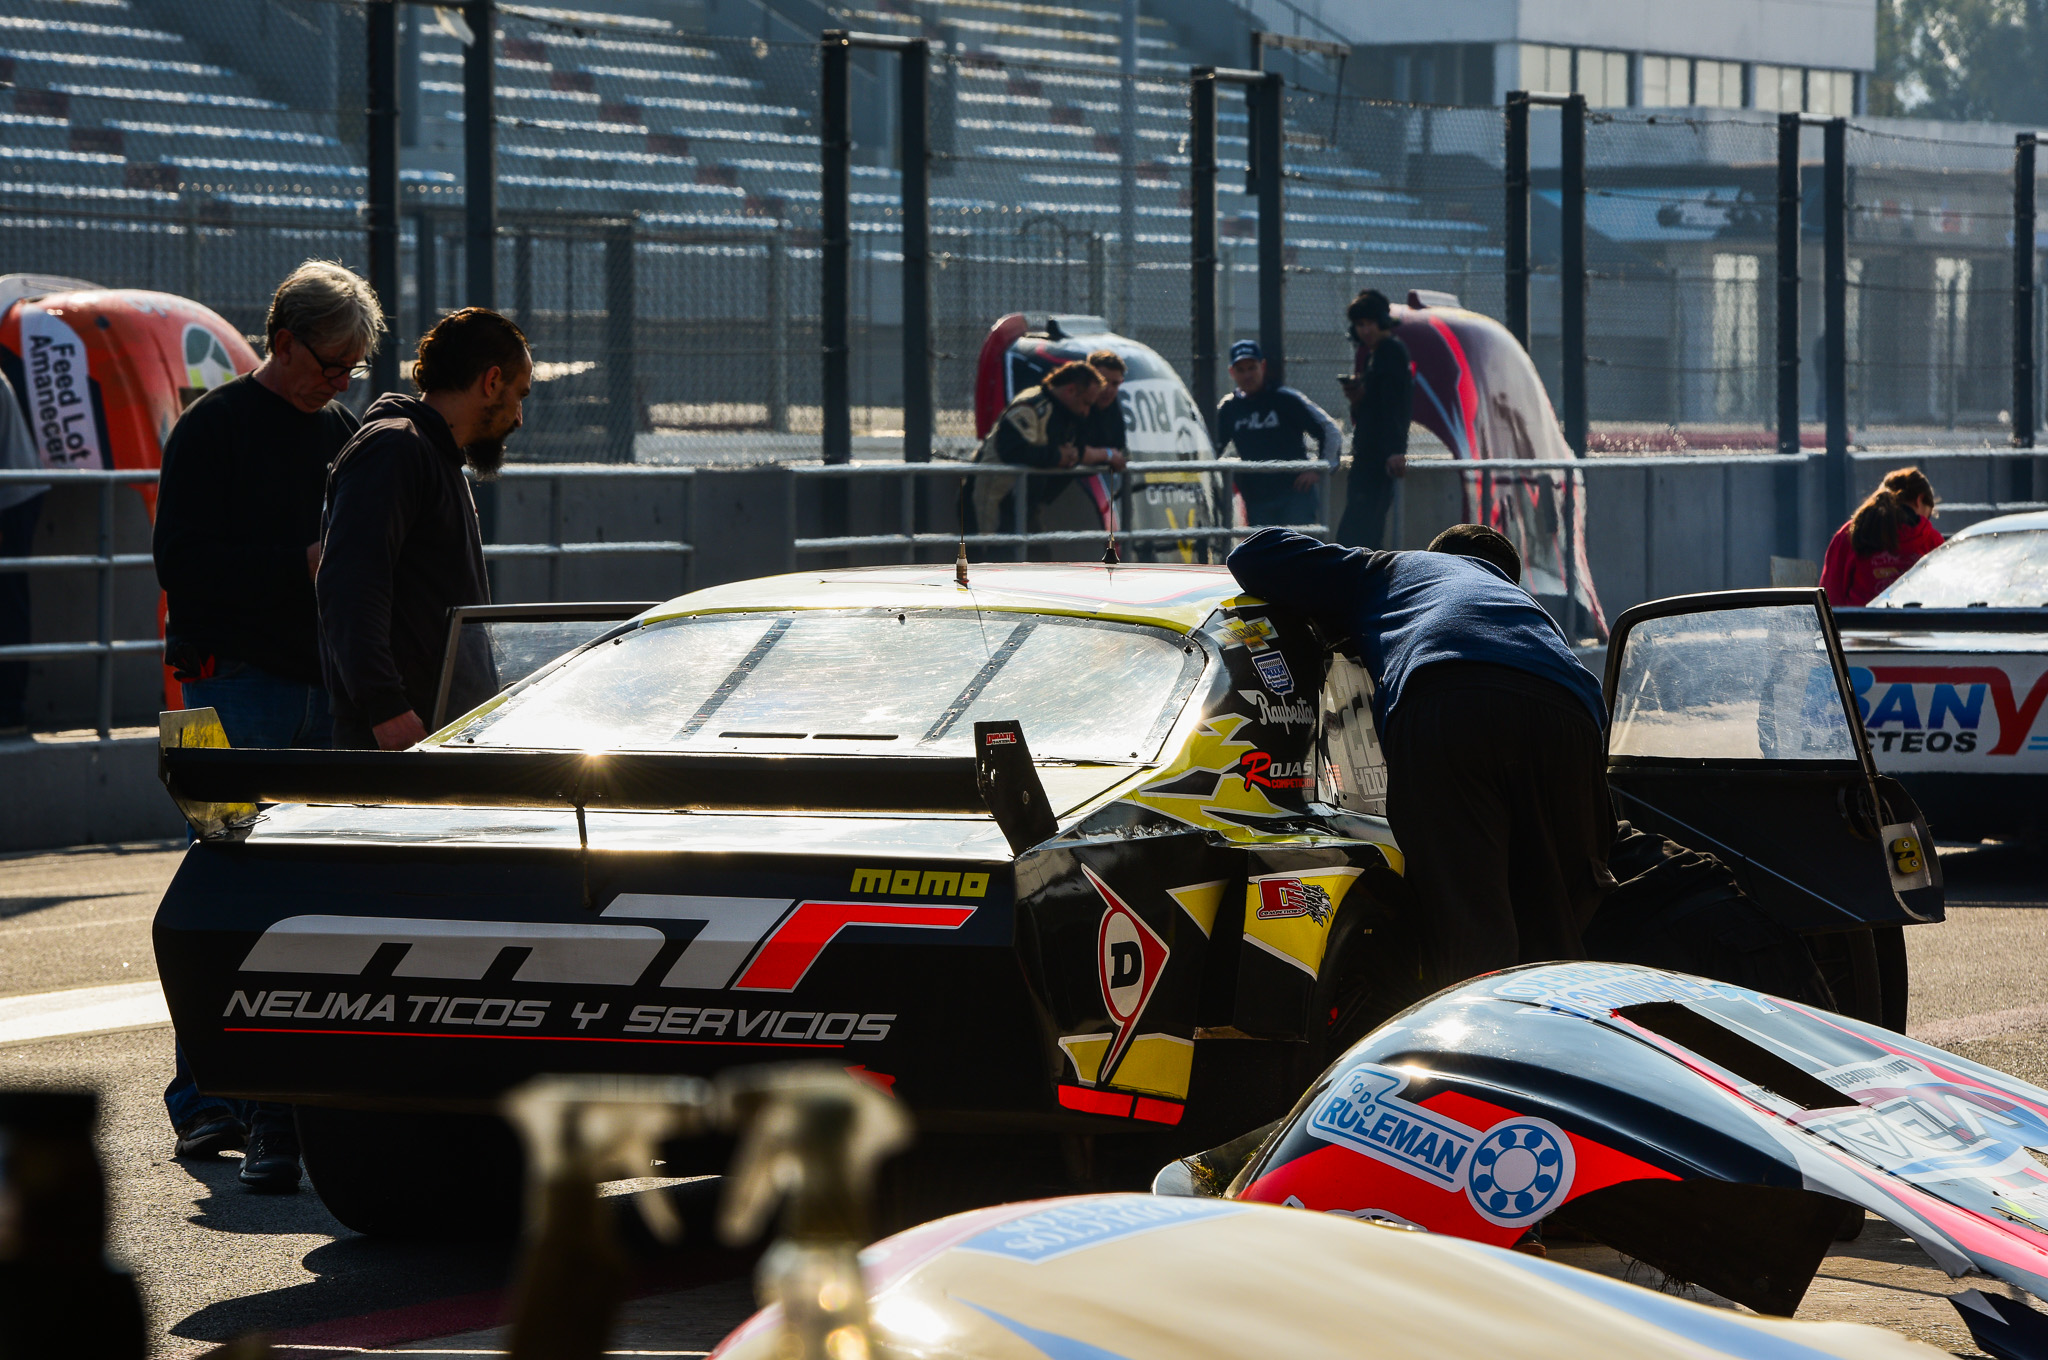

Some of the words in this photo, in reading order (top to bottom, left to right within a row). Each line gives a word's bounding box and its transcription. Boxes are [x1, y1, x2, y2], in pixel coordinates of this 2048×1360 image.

[29, 335, 68, 464] Amanecer
[51, 343, 83, 407] Feed
[62, 413, 92, 460] Lot
[1110, 941, 1142, 989] D
[223, 990, 552, 1027] NEUMATICOS
[571, 1002, 609, 1030] Y
[623, 1005, 897, 1041] SERVICIOS
[1348, 1075, 1376, 1117] TODO
[1319, 1097, 1468, 1175] RULEMAN
